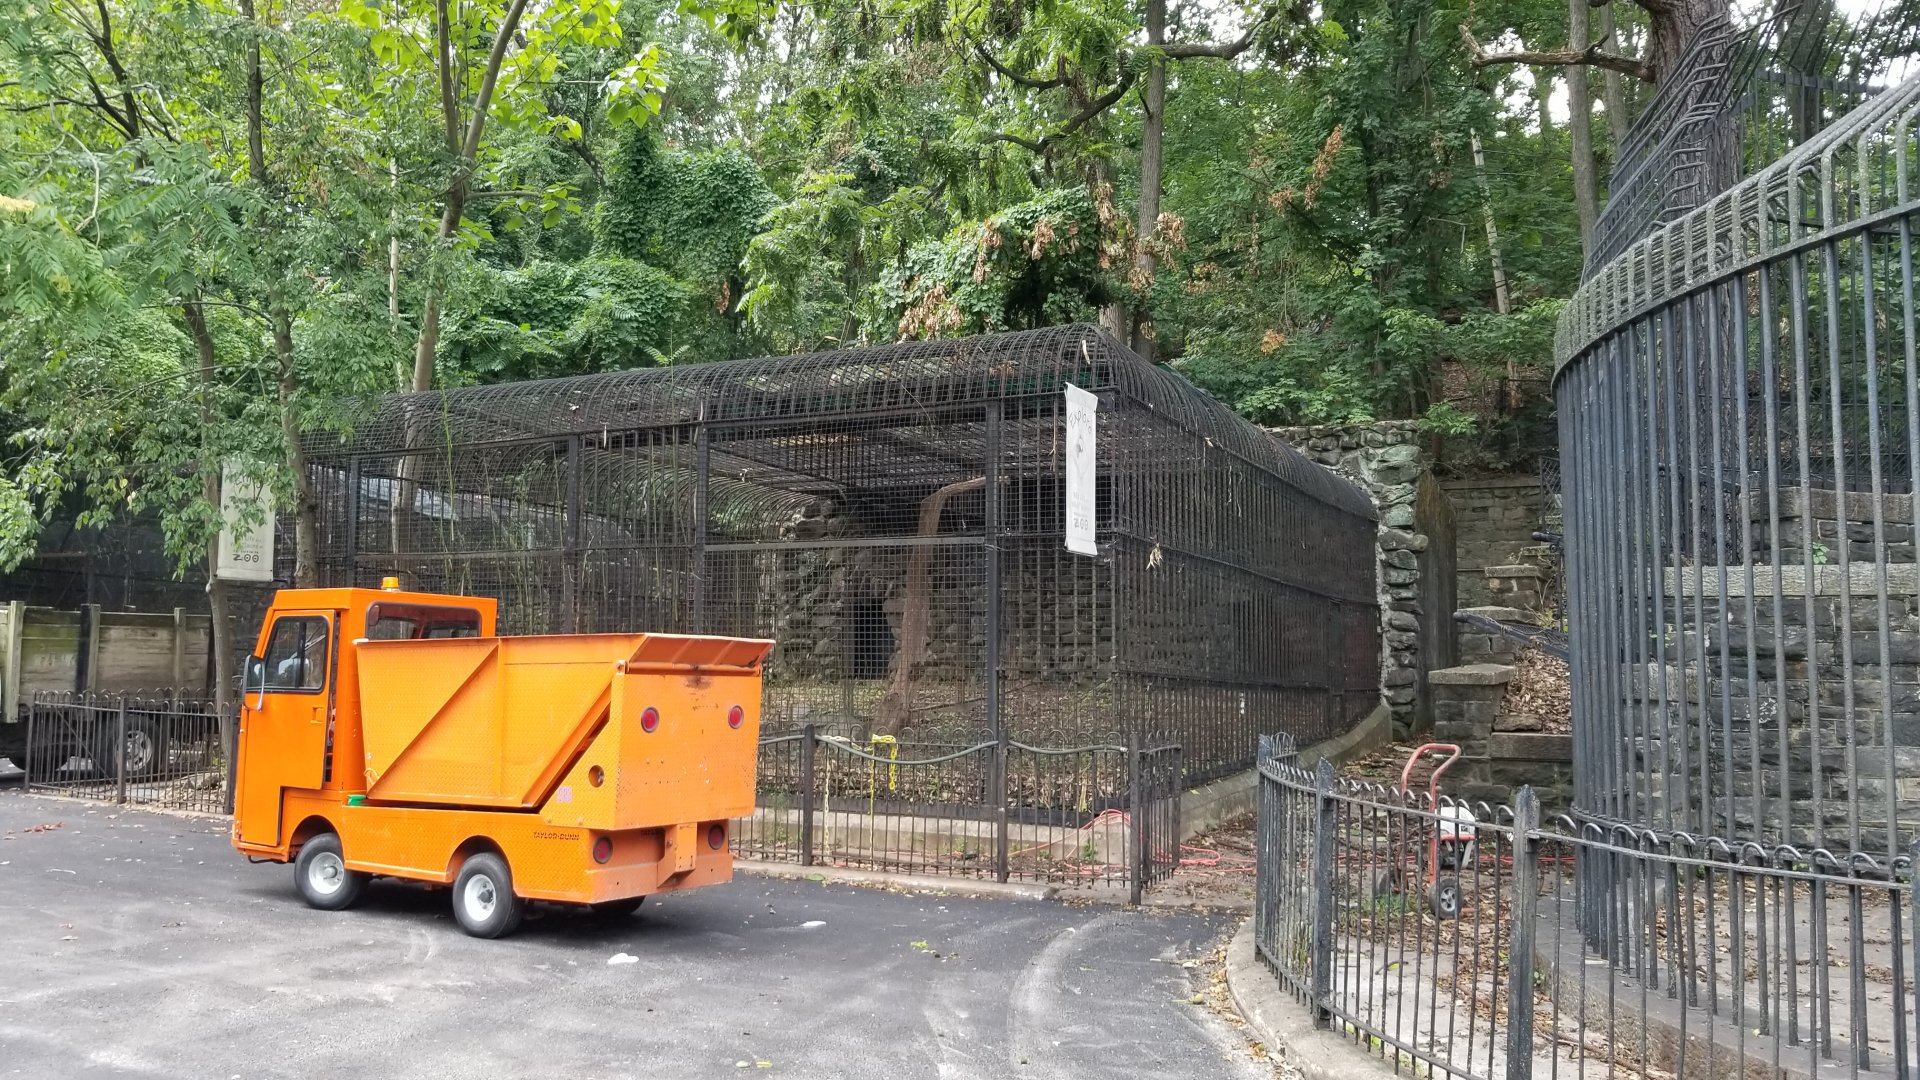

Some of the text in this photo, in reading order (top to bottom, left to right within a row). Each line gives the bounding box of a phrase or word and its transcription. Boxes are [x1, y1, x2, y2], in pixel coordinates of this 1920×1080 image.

[1073, 518, 1089, 531] ZOO
[232, 553, 260, 563] ZOO
[533, 831, 580, 841] TAYLOR-DUNN
